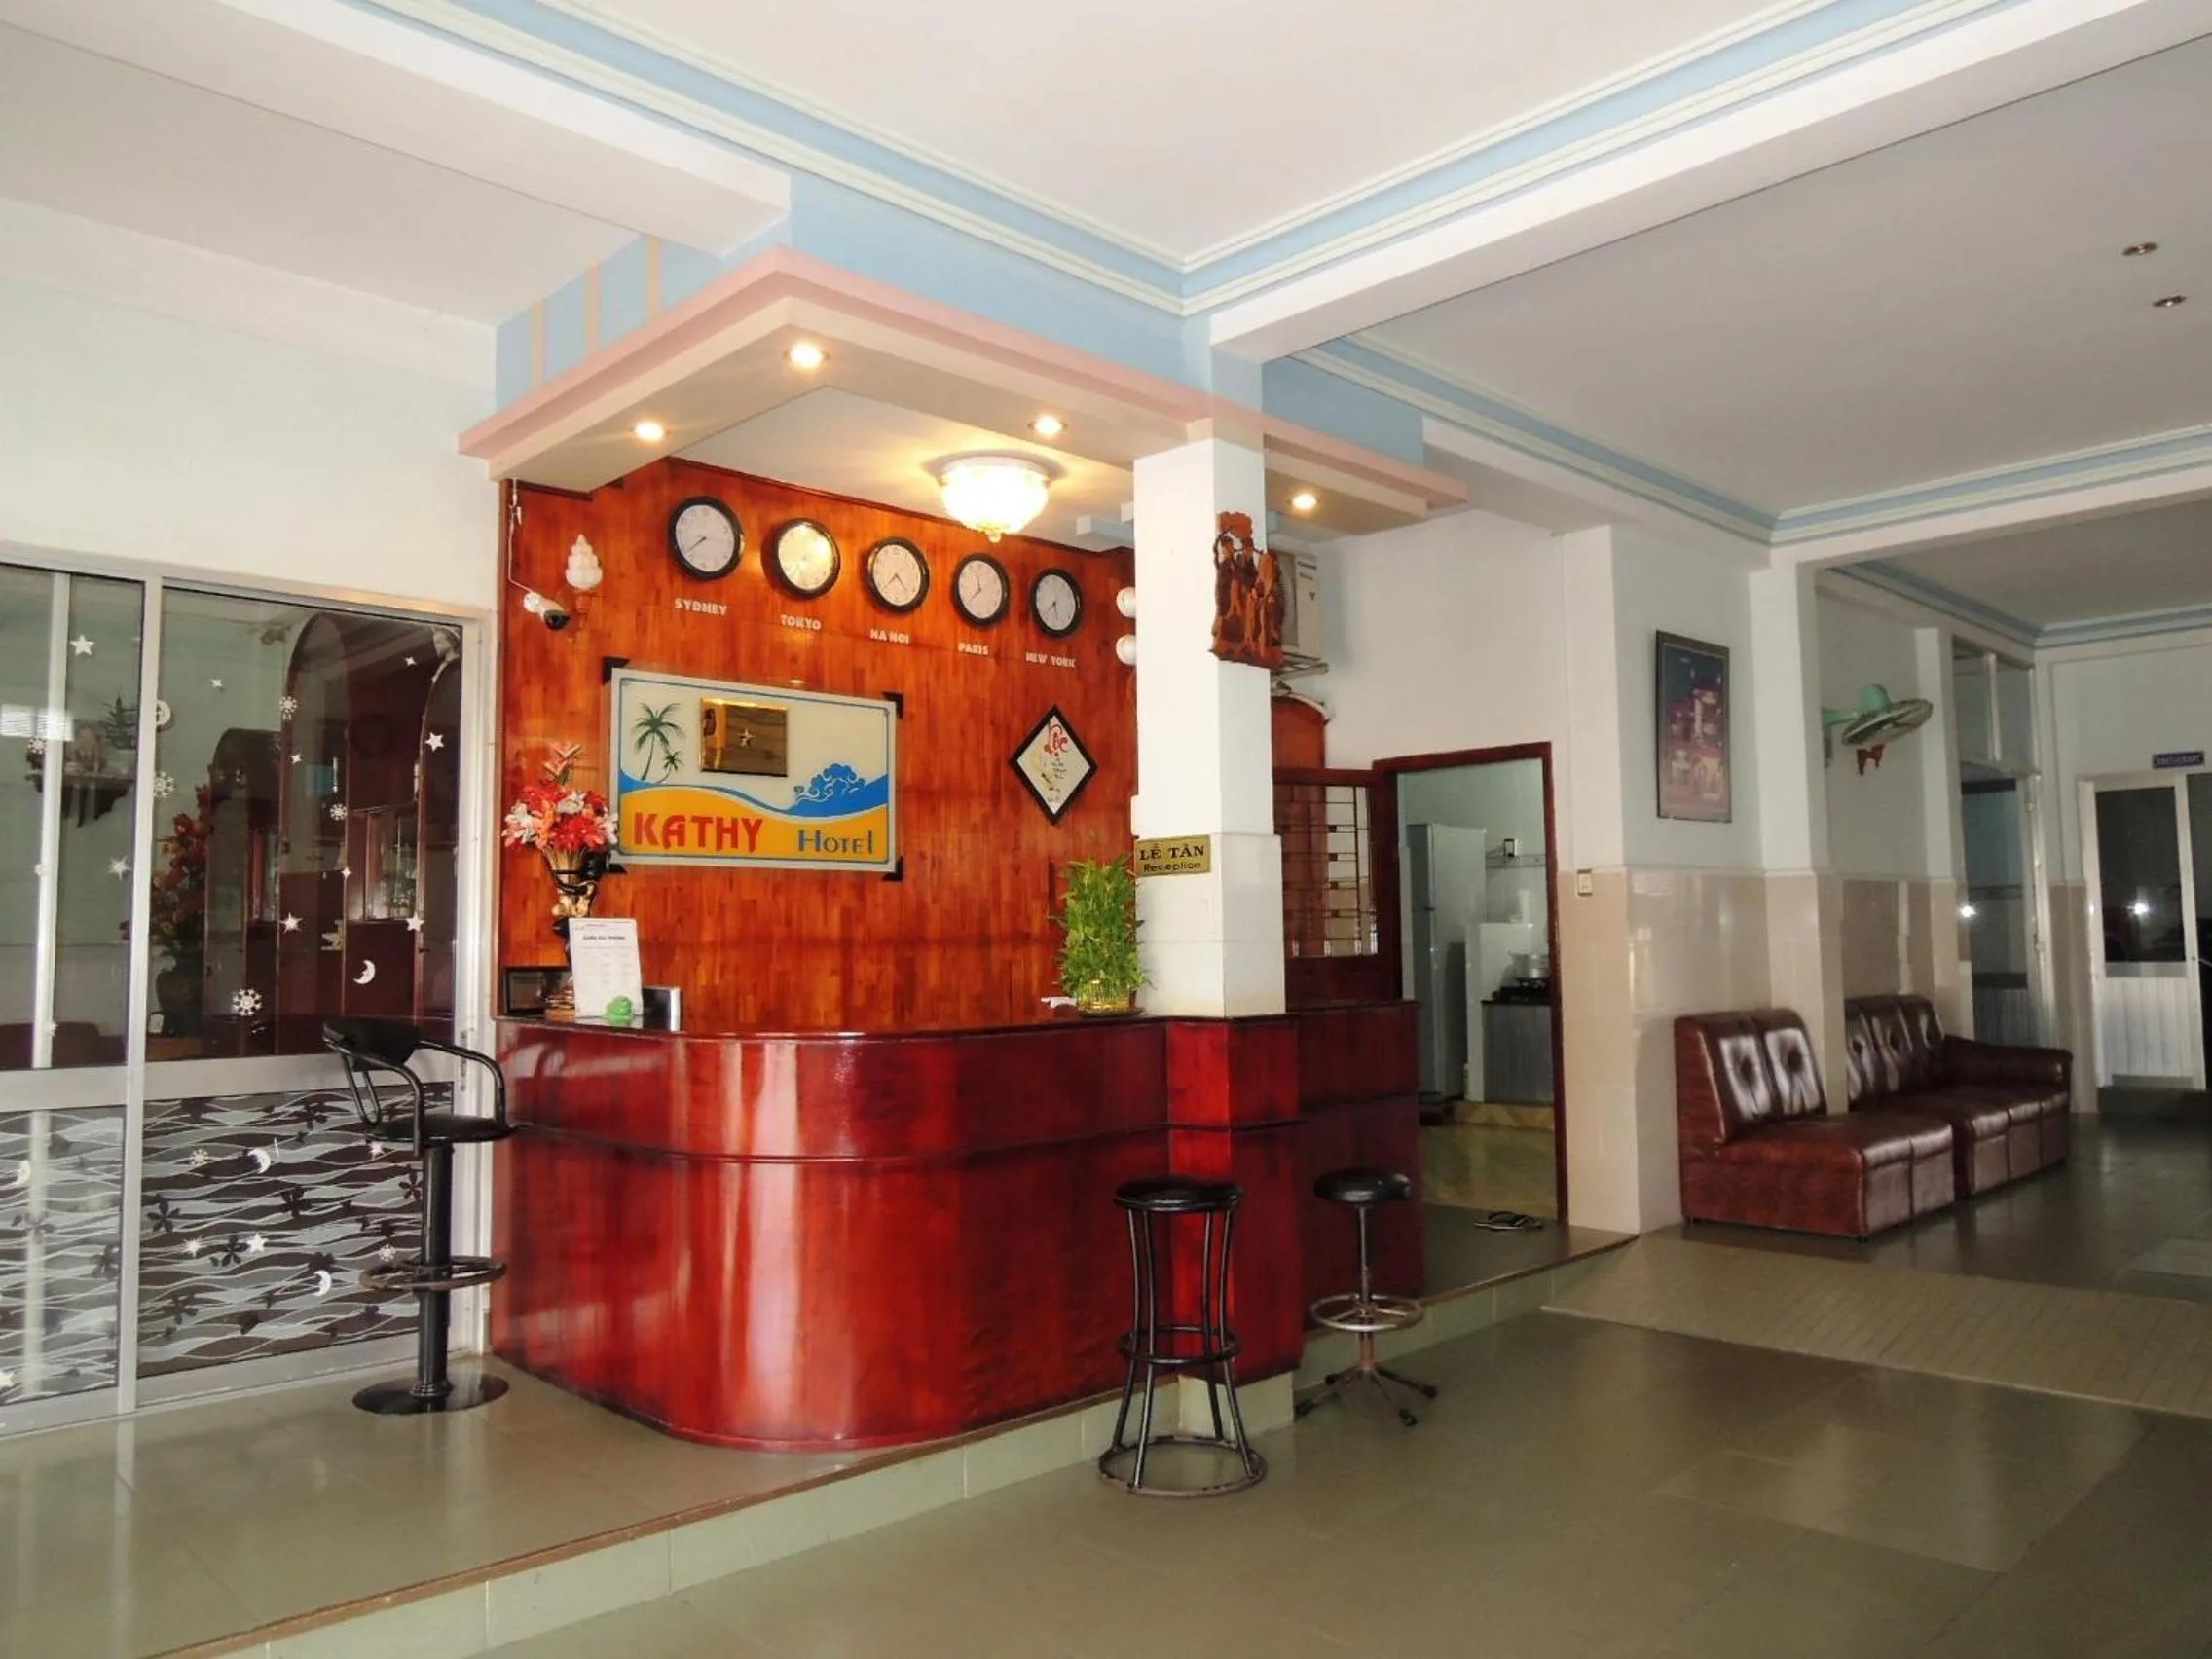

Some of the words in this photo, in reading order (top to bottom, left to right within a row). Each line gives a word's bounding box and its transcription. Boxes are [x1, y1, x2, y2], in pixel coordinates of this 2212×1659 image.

[675, 598, 727, 616] SYDNEY
[781, 614, 822, 631] TOKYO
[958, 643, 989, 655] PARIS
[1026, 652, 1047, 664] NEW
[1051, 655, 1076, 668] YORK
[634, 811, 763, 854] KATHY
[1144, 862, 1202, 873] Reception
